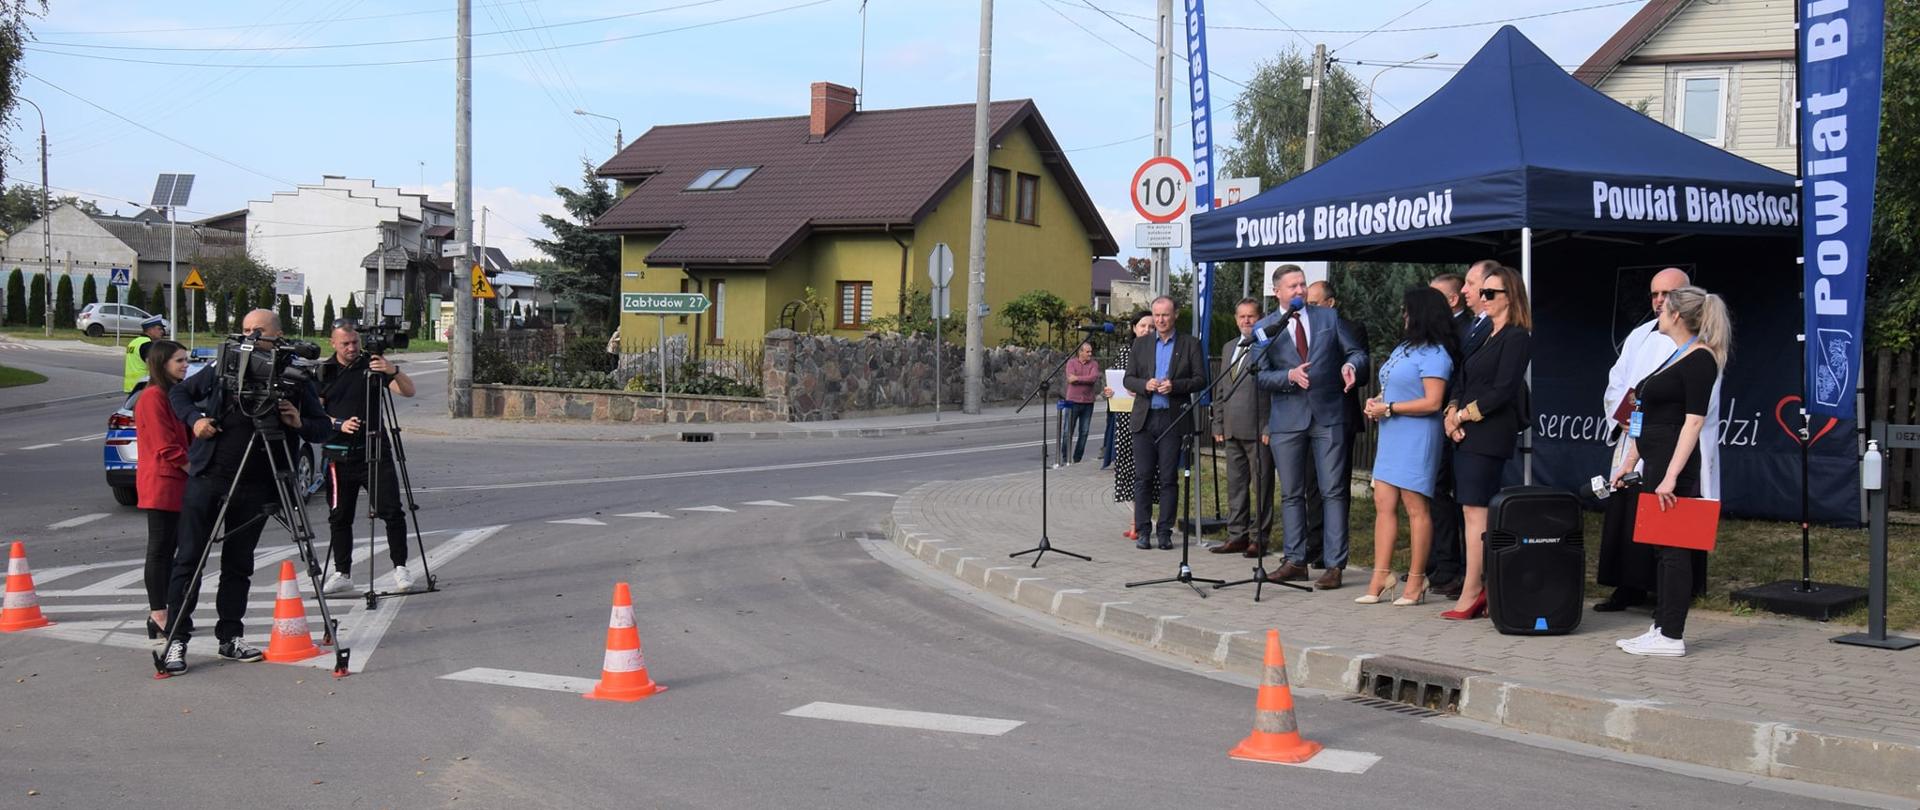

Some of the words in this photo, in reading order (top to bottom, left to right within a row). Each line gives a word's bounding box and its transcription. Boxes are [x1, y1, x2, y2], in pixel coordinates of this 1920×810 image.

[1236, 208, 1306, 249] Powiat
[1313, 188, 1453, 241] Białostocki
[1593, 180, 1678, 222] Powiat
[1807, 87, 1849, 316] Powiat
[624, 296, 683, 308] Zabłudów
[689, 296, 703, 308] 27
[1718, 397, 1761, 446] dzi
